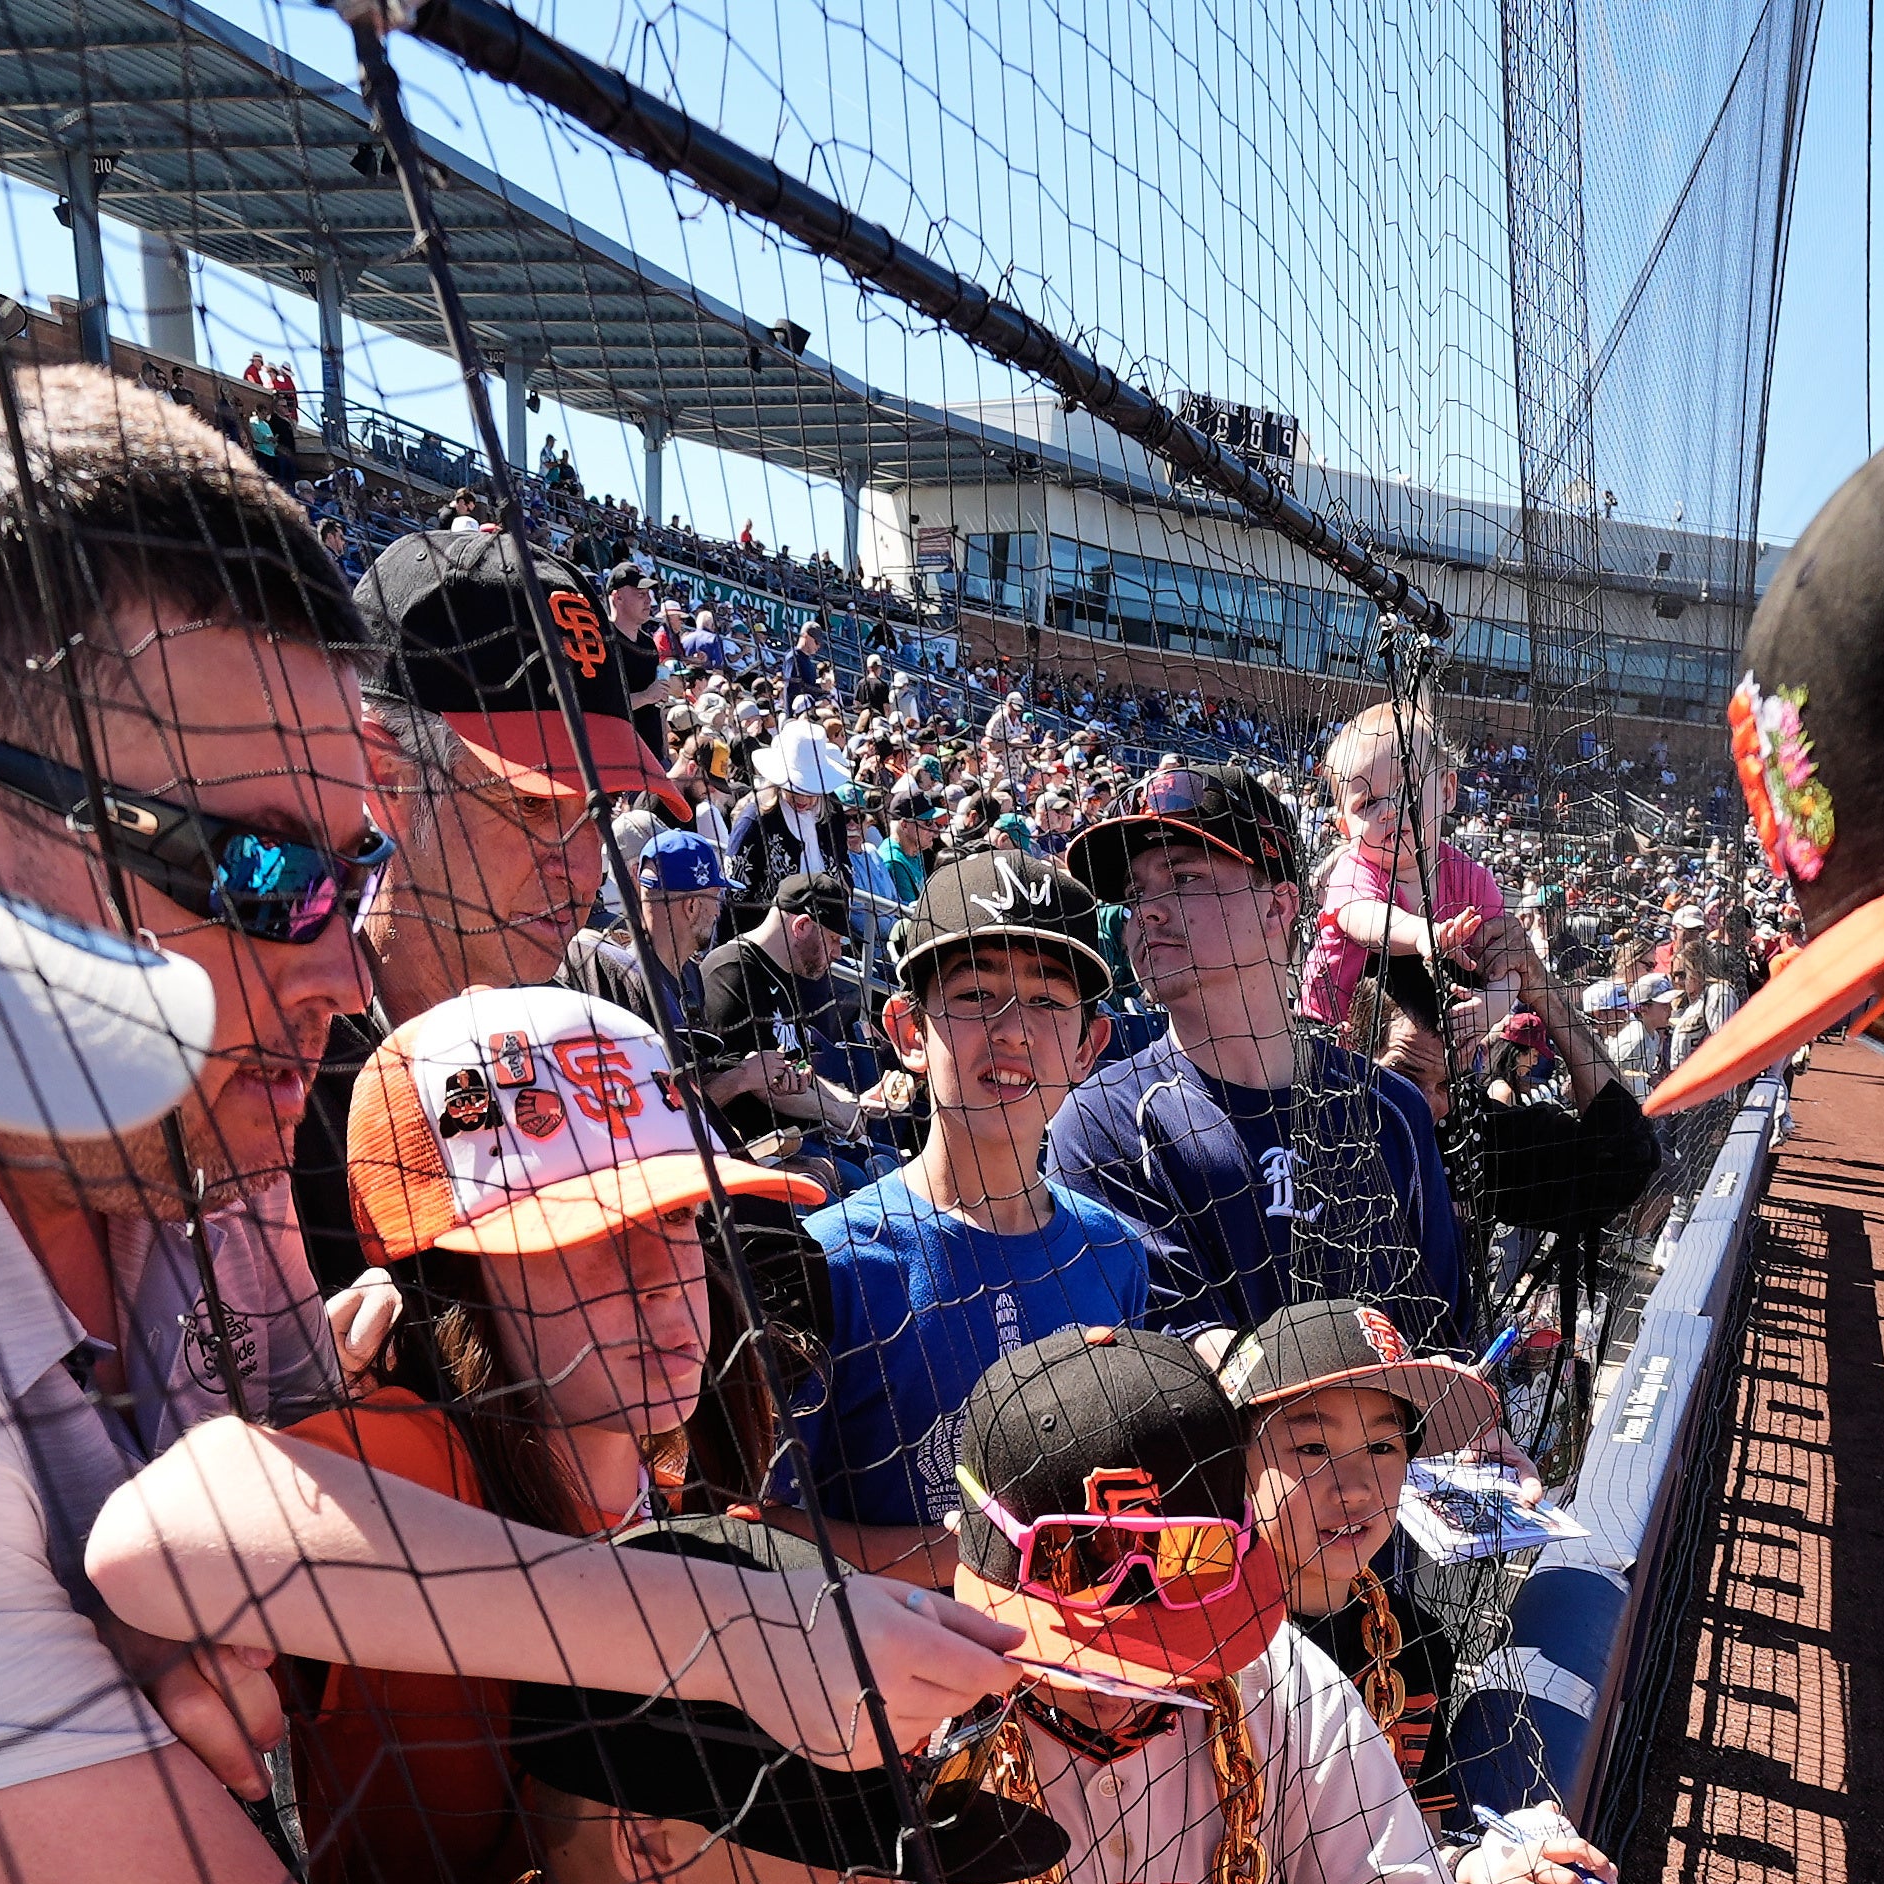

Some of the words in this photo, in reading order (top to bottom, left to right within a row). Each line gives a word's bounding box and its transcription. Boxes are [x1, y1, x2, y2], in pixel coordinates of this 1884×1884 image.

[93, 157, 112, 174] 210
[298, 269, 316, 282] 308
[1250, 421, 1263, 449] 0
[1282, 429, 1293, 455] 9
[548, 591, 607, 678] SF
[552, 1033, 644, 1139] SF
[996, 1293, 1015, 1310] MAX
